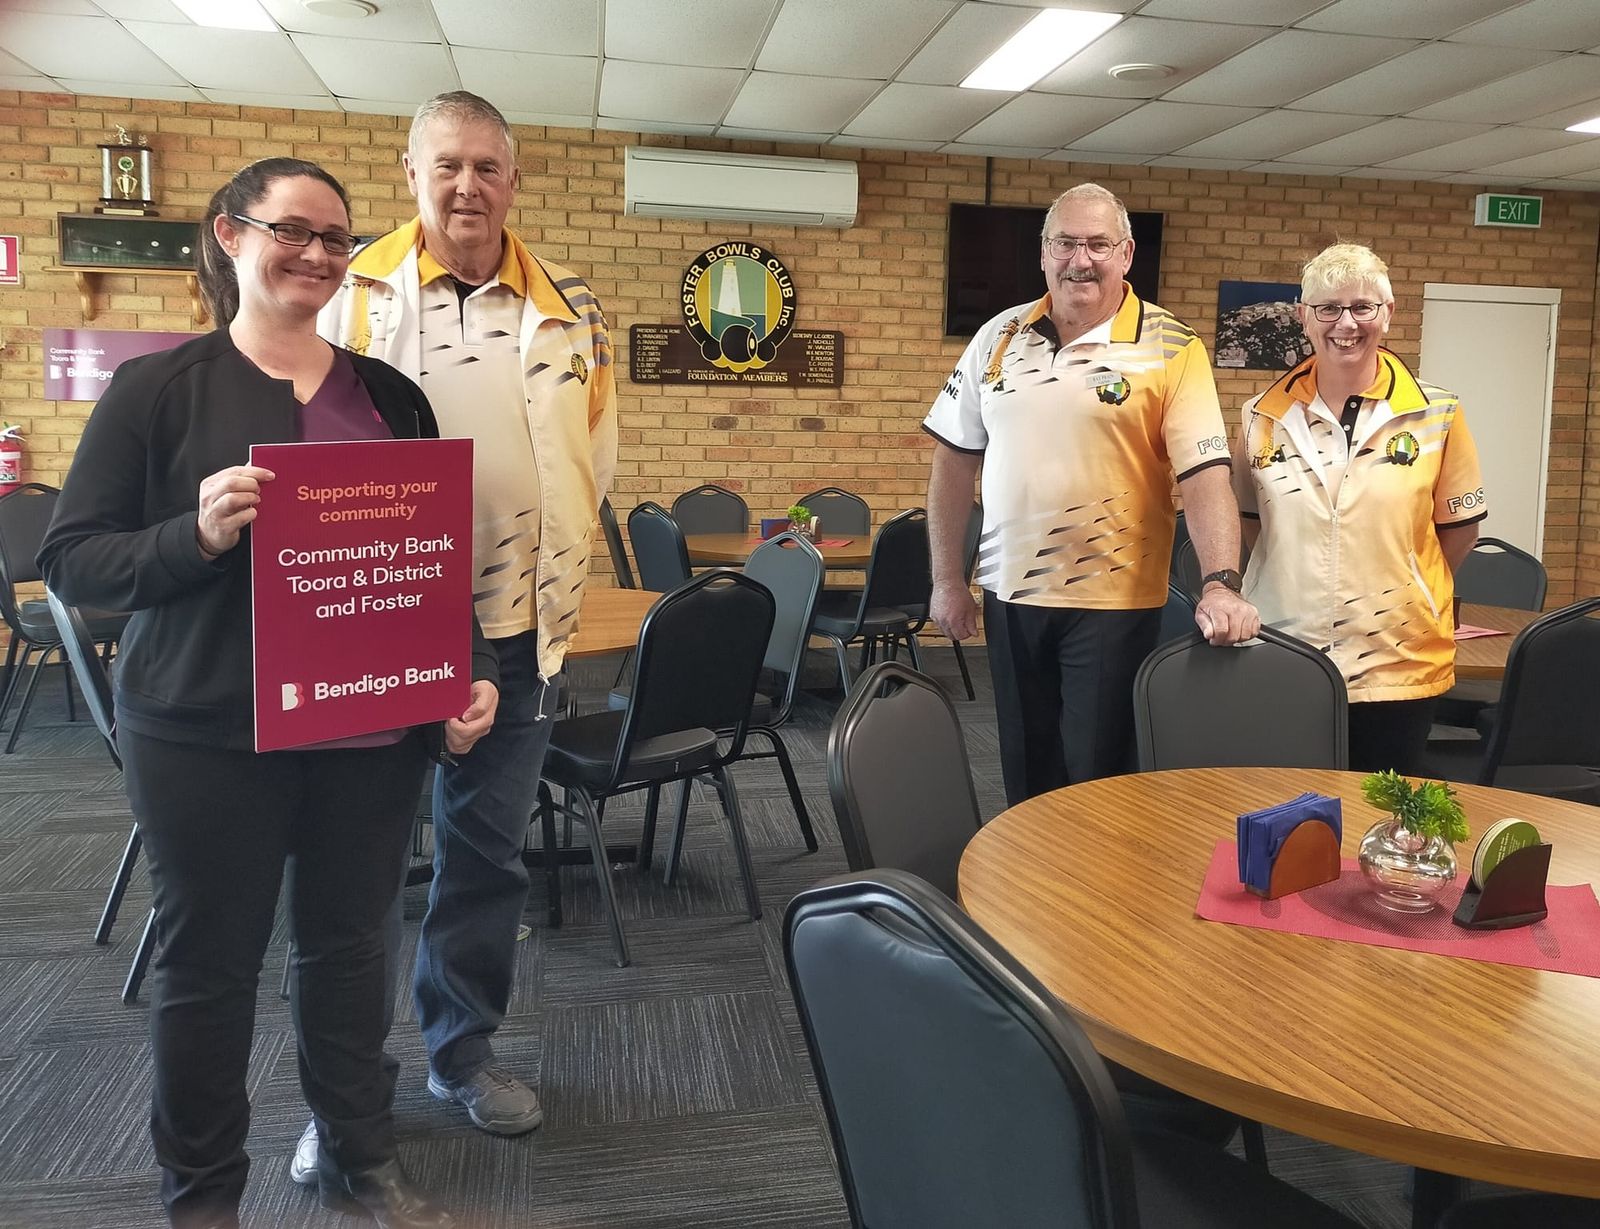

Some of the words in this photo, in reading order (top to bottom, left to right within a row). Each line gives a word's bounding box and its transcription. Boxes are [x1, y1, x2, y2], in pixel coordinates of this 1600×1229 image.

[1498, 201, 1531, 221] EXIT
[705, 243, 762, 263] BOWLS
[766, 259, 794, 299] CLUB
[683, 264, 704, 328] FOSTER
[776, 305, 794, 330] Inc.
[67, 367, 114, 381] Bendigo
[687, 373, 738, 381] FOUNDATION
[742, 374, 788, 382] MEMBERS
[297, 481, 396, 504] Supporting
[400, 481, 438, 499] your
[1447, 487, 1486, 514] FOS
[319, 502, 417, 523] community
[278, 540, 400, 567] Community
[405, 534, 454, 555] Bank
[287, 576, 347, 594] Toora
[353, 570, 368, 586] &
[373, 562, 443, 585] District
[316, 597, 355, 618] and
[361, 592, 423, 613] Foster
[314, 674, 400, 700] Bendigo
[405, 662, 455, 685] Bank
